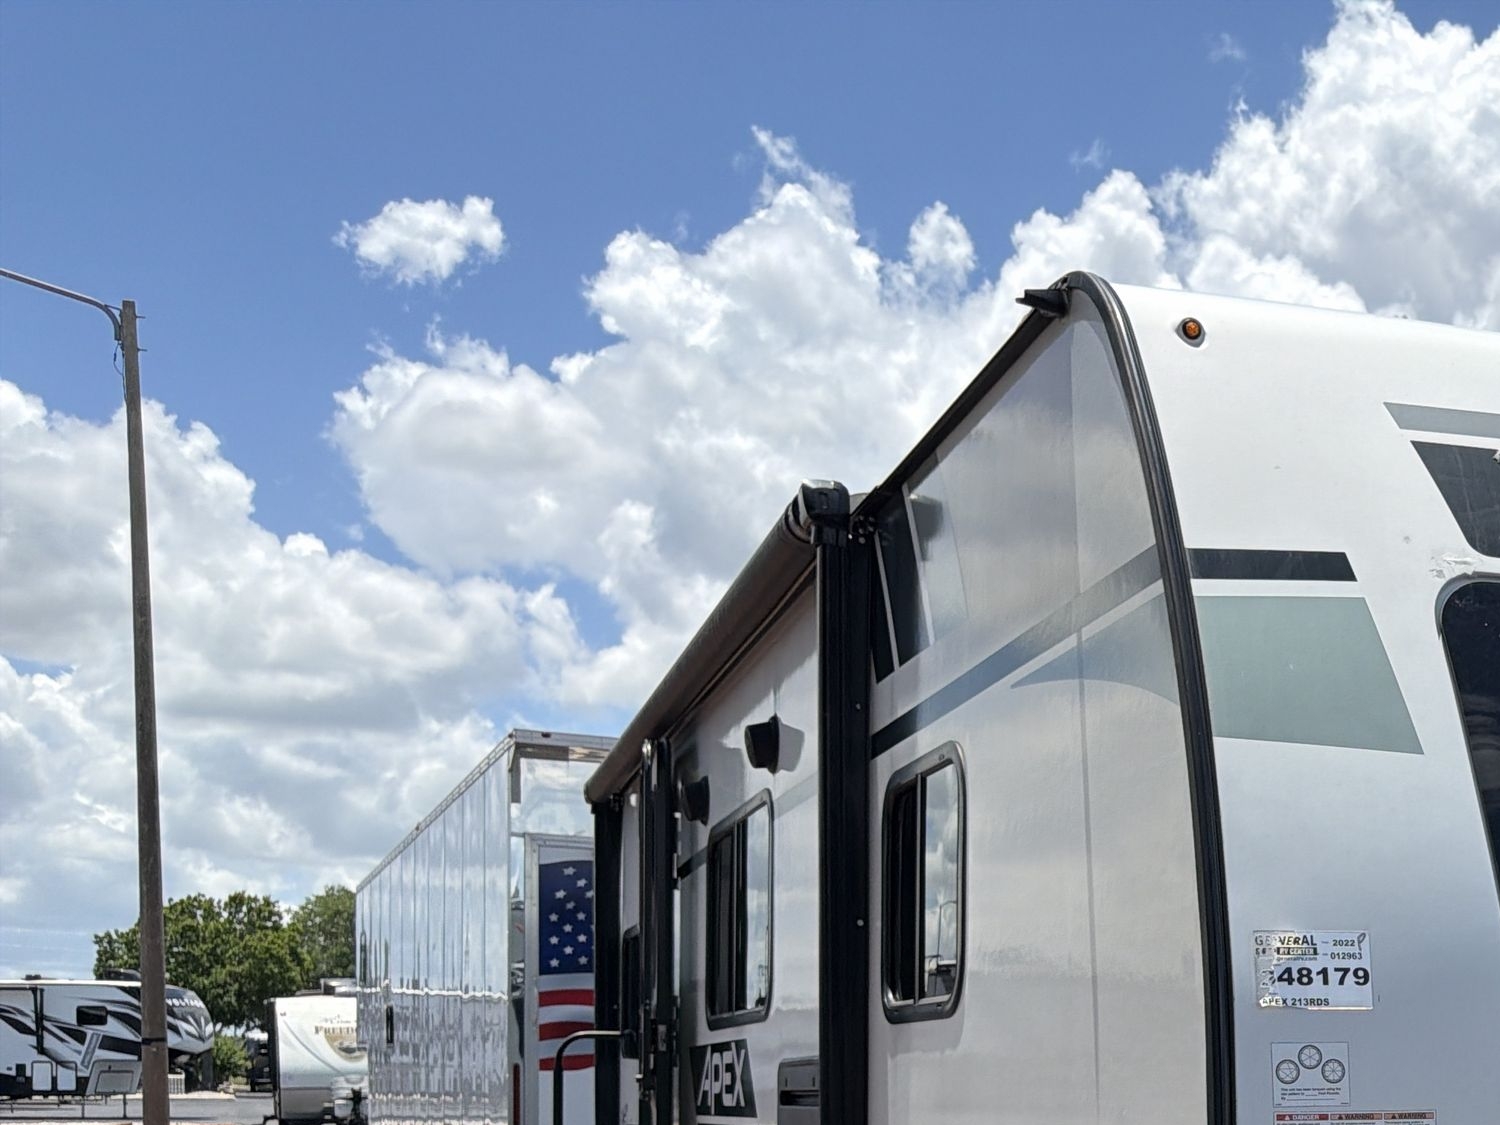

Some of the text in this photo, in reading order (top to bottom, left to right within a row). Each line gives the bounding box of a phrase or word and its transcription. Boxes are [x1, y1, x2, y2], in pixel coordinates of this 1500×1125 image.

[1330, 952, 1362, 960] 012963
[1262, 998, 1330, 1007] APEX 213RDS
[697, 1042, 746, 1115] APEX
